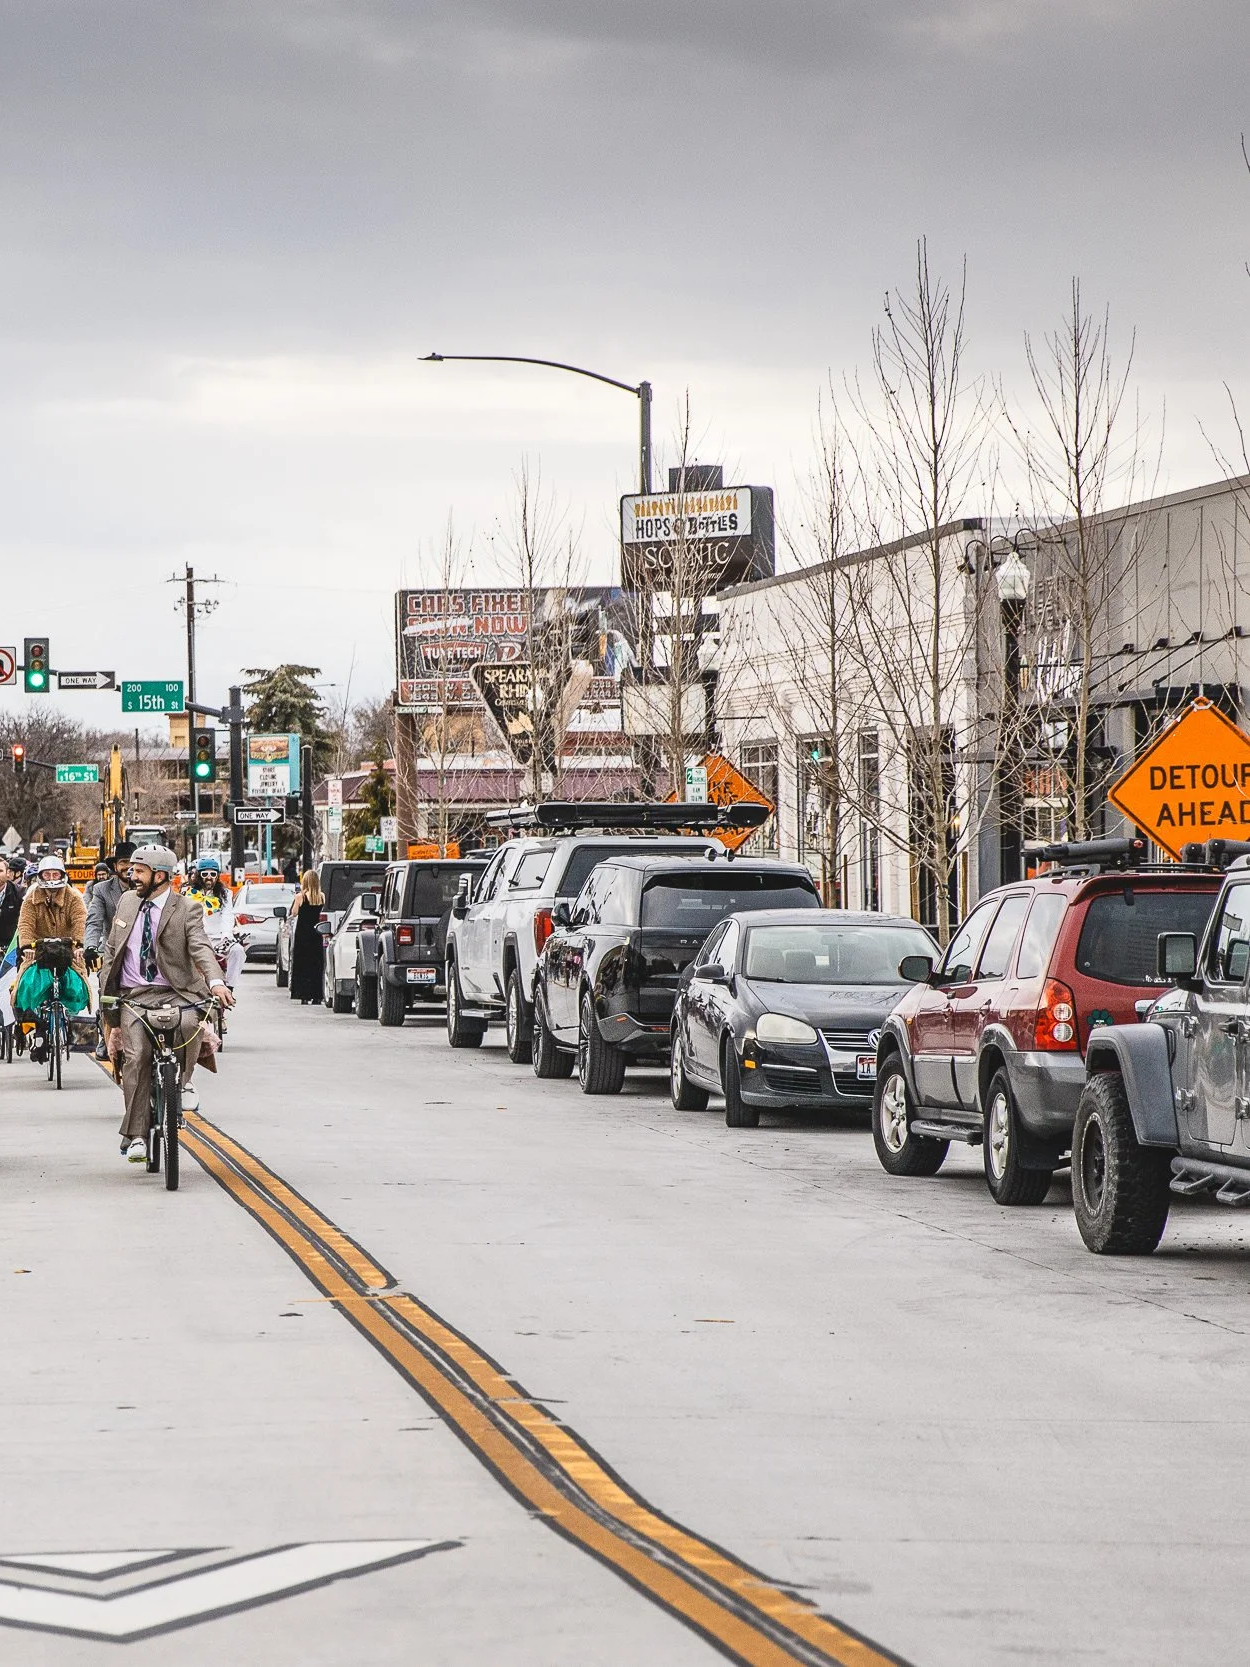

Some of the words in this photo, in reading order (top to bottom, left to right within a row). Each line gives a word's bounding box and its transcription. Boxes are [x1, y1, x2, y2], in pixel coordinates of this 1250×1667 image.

[636, 518, 671, 539] HOPS
[644, 542, 730, 569] SCNIC
[407, 594, 465, 614] CARS
[473, 615, 529, 635] NOW
[456, 647, 481, 659] TECH
[127, 684, 142, 693] 200
[165, 683, 179, 692] 100
[127, 701, 133, 710] S
[138, 694, 165, 710] 15th
[171, 701, 179, 710] St
[83, 772, 95, 781] St
[686, 769, 693, 783] 2
[68, 870, 94, 879] ETOUR
